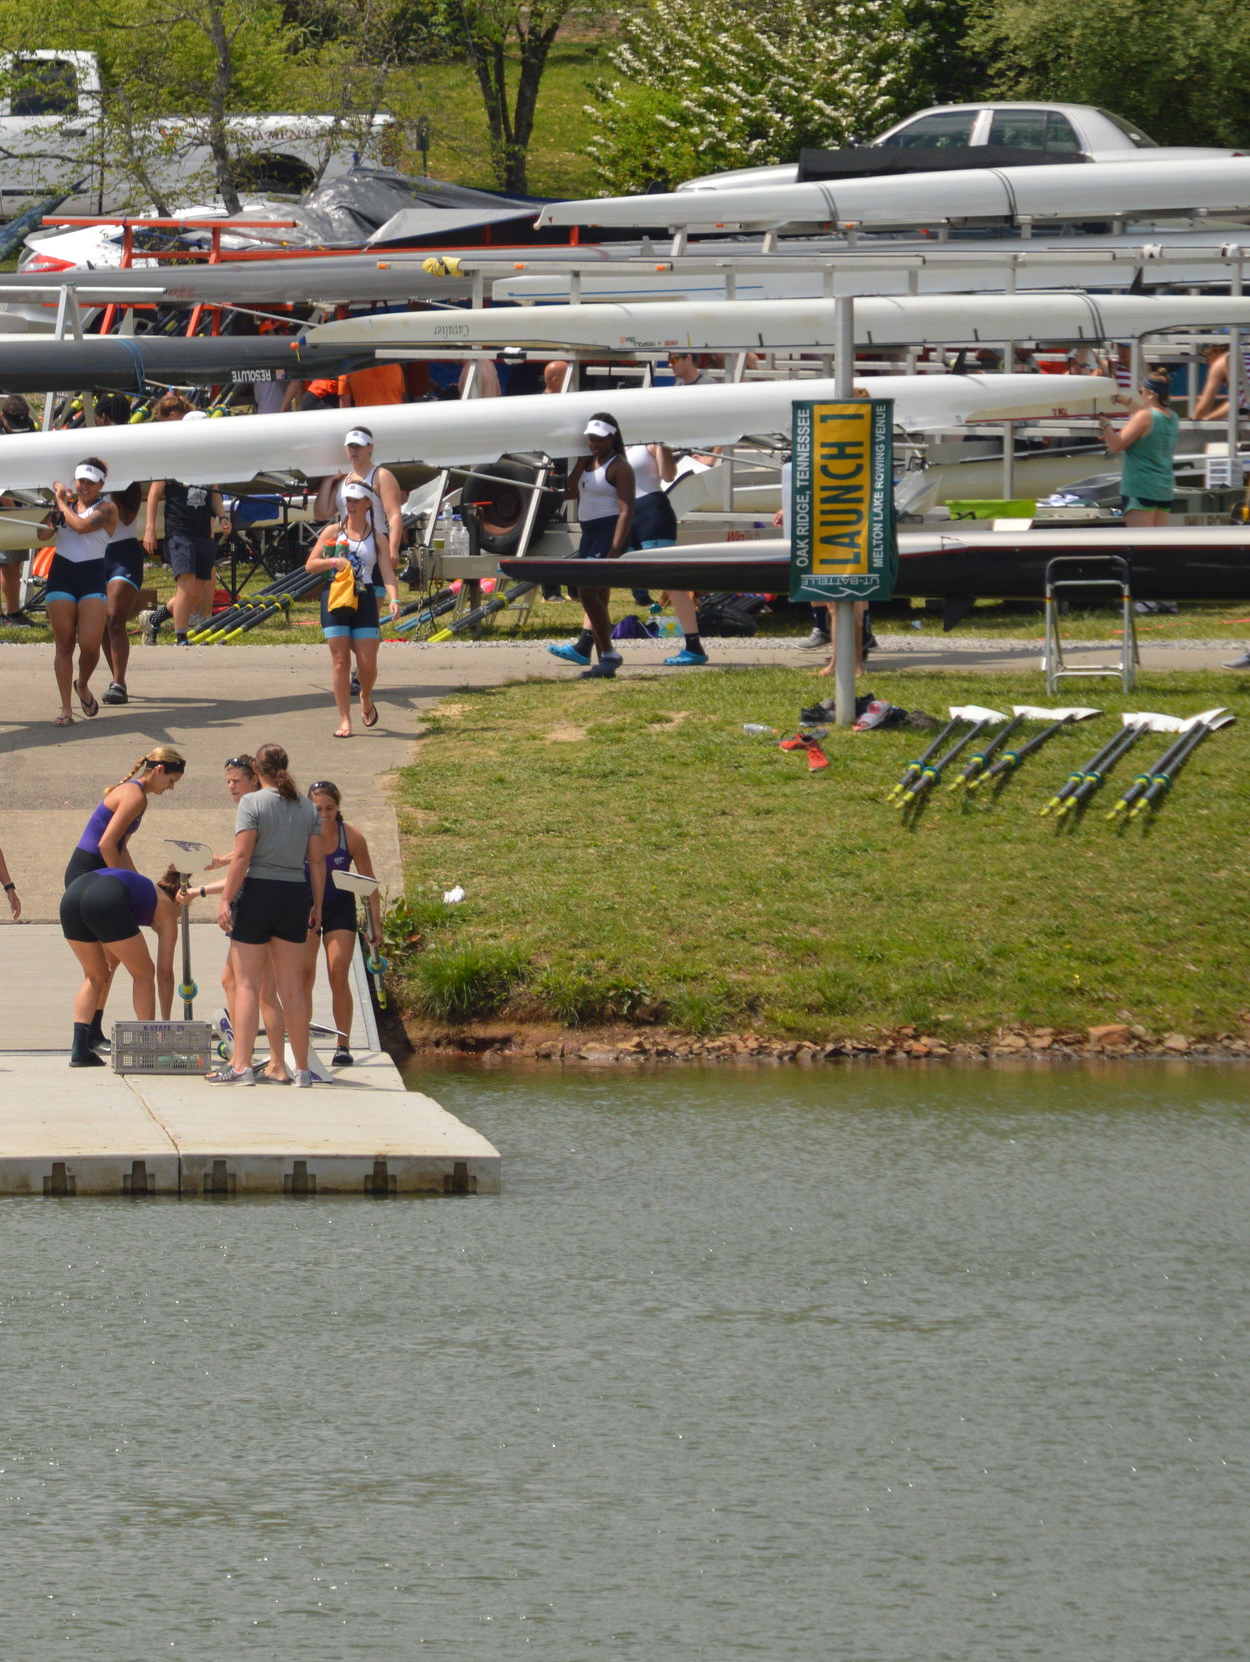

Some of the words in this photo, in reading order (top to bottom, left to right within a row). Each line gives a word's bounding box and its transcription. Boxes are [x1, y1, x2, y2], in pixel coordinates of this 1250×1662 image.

[433, 323, 470, 339] Cavalier
[231, 369, 272, 382] RESOLUTE
[819, 413, 865, 424] 1
[875, 404, 887, 441] VENUE
[797, 408, 811, 488] TENNESSEE
[874, 444, 885, 489] ROWING
[797, 490, 812, 536] RIDGE,
[818, 441, 864, 565] LAUNCH
[873, 490, 885, 522] LAKE
[796, 539, 810, 568] OAK
[873, 523, 884, 568] MELTON
[801, 576, 880, 586] UT-BATTELLE
